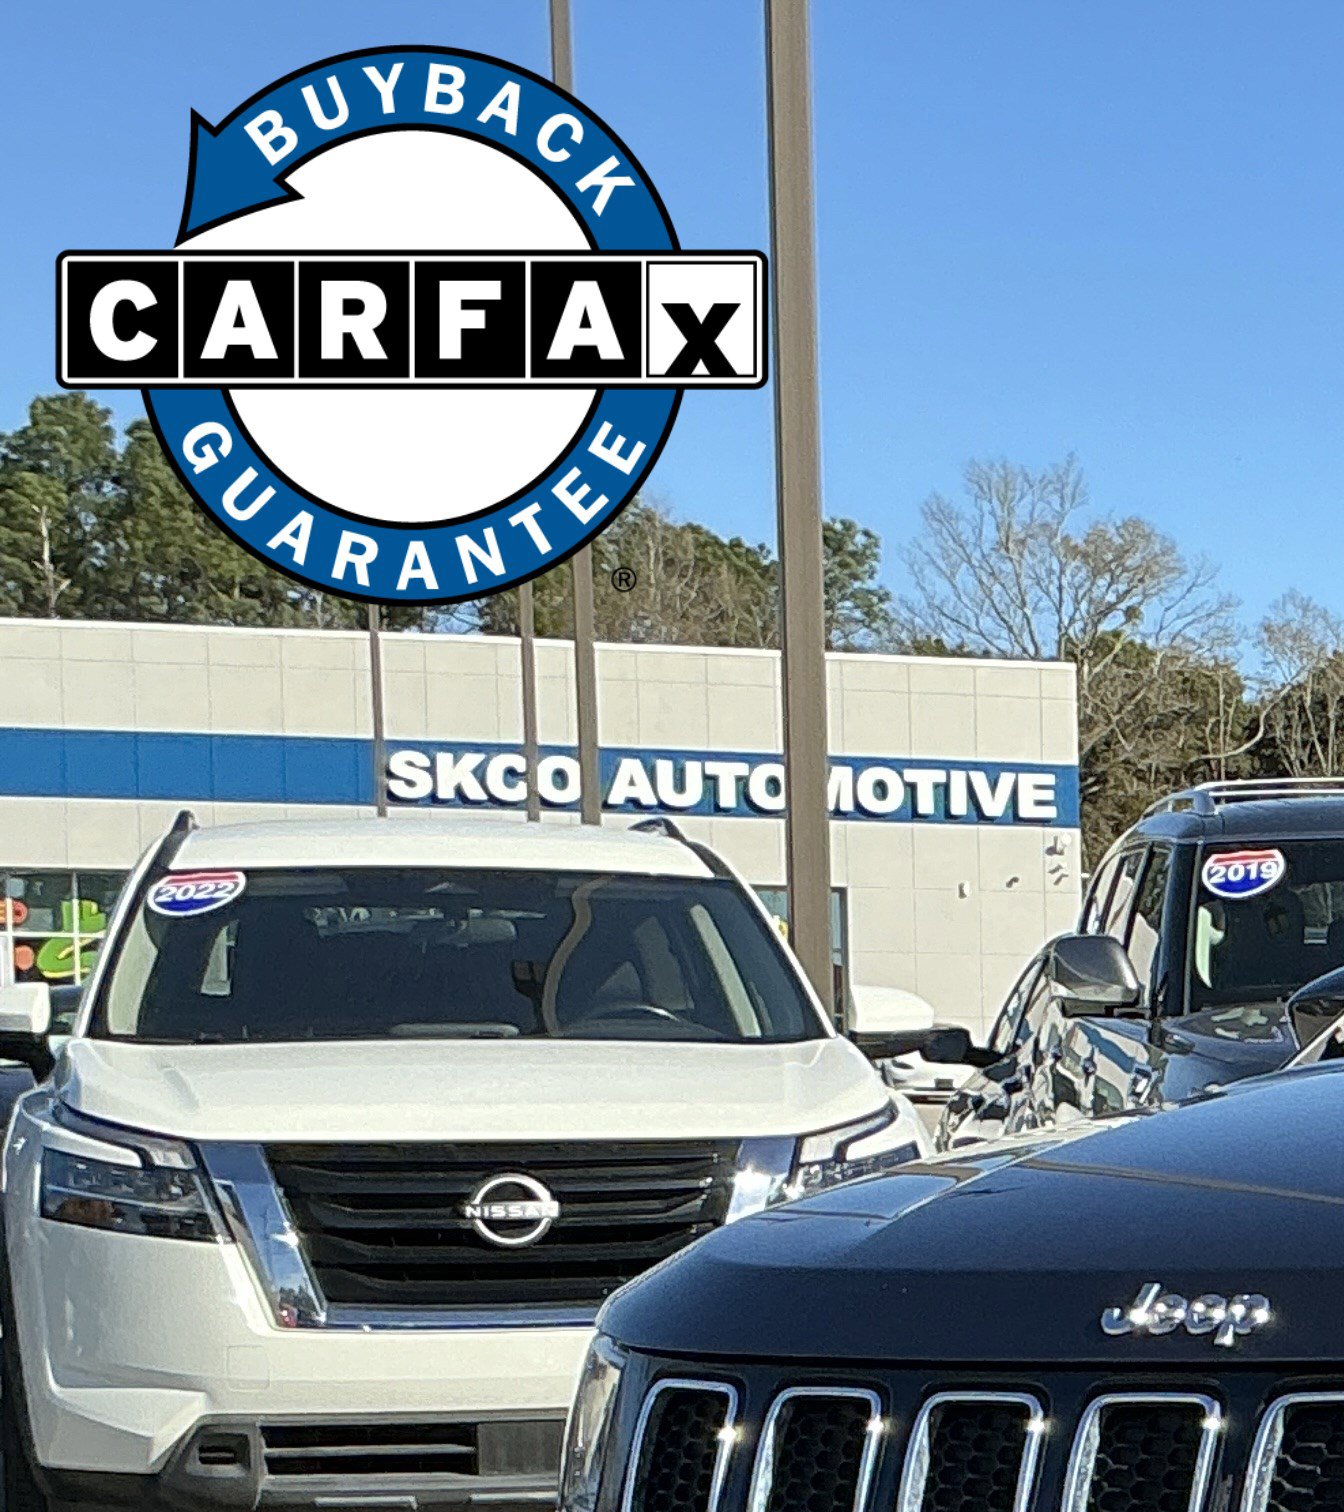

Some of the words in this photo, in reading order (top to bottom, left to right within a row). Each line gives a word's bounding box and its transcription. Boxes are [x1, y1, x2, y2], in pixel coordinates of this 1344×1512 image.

[388, 750, 582, 804] SKCO
[606, 758, 1058, 819] AUTOOTIVE
[1209, 860, 1279, 884] 2019
[154, 882, 236, 901] 2022
[465, 1202, 559, 1219] NISSAN
[1101, 1282, 1270, 1347] Jeep
